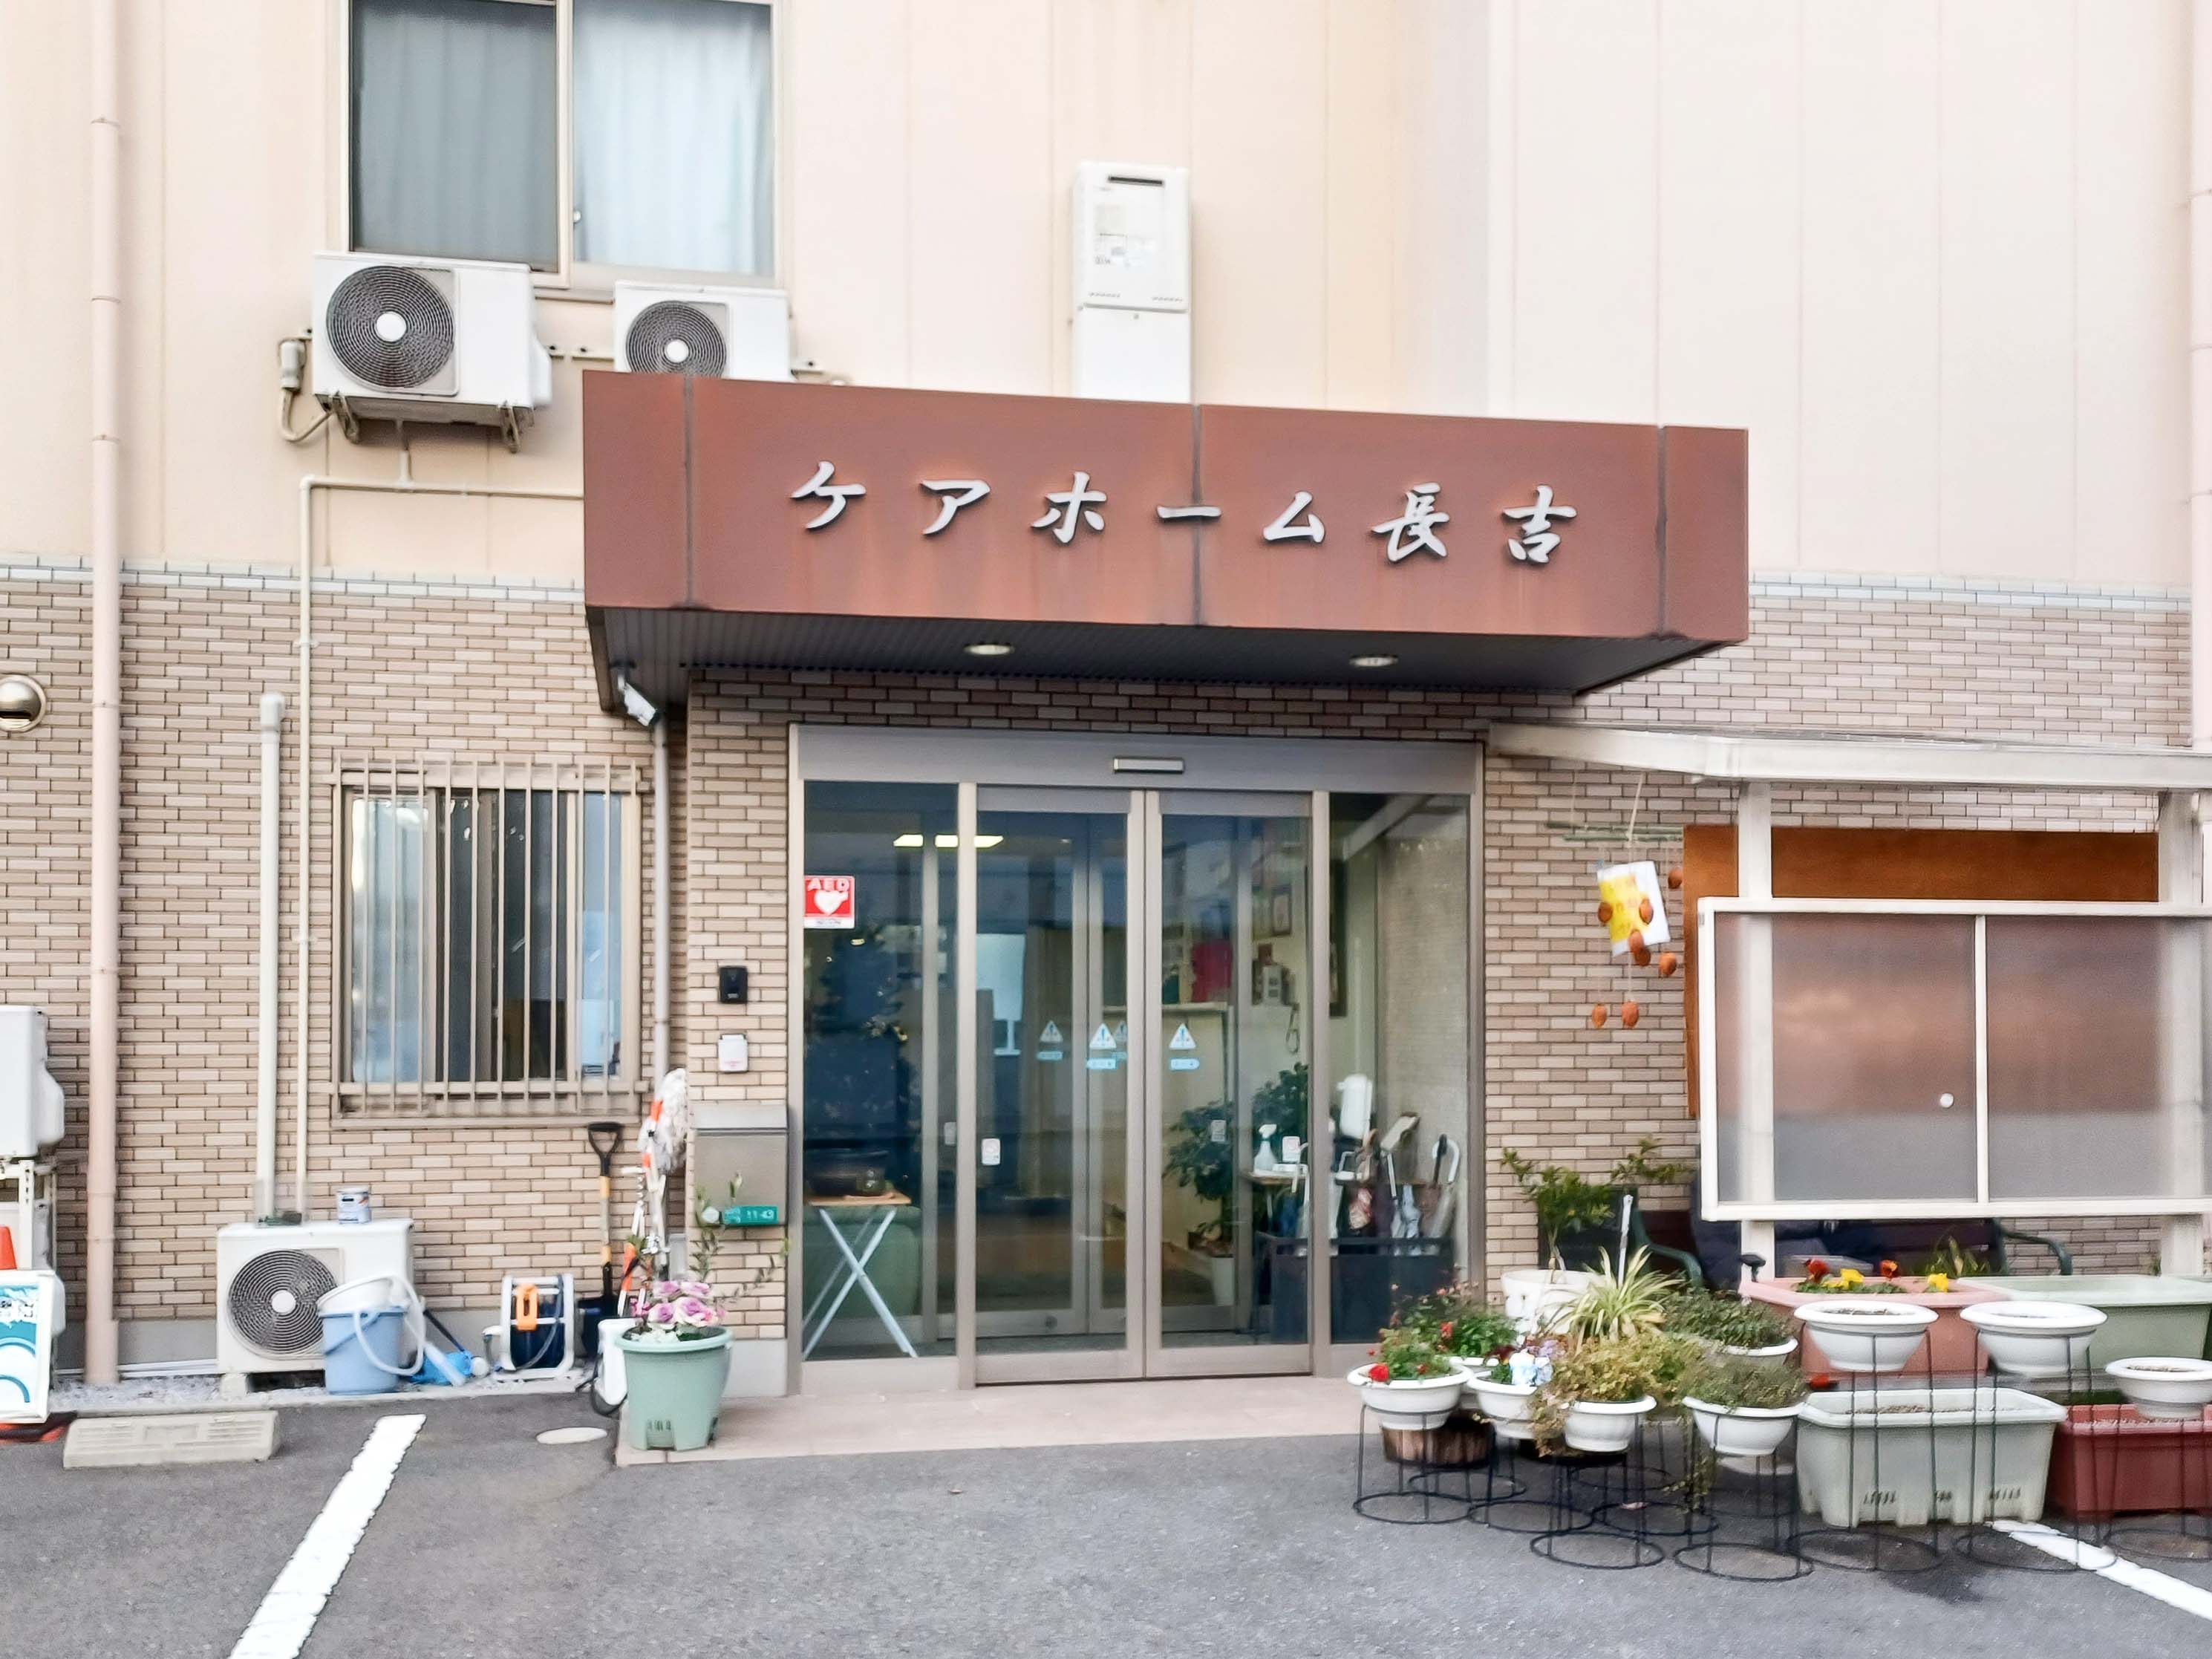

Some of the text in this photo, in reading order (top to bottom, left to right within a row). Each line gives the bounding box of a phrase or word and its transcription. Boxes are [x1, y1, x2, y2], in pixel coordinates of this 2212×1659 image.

[790, 460, 1579, 567] ケアホーム長吉
[807, 878, 850, 893] AED
